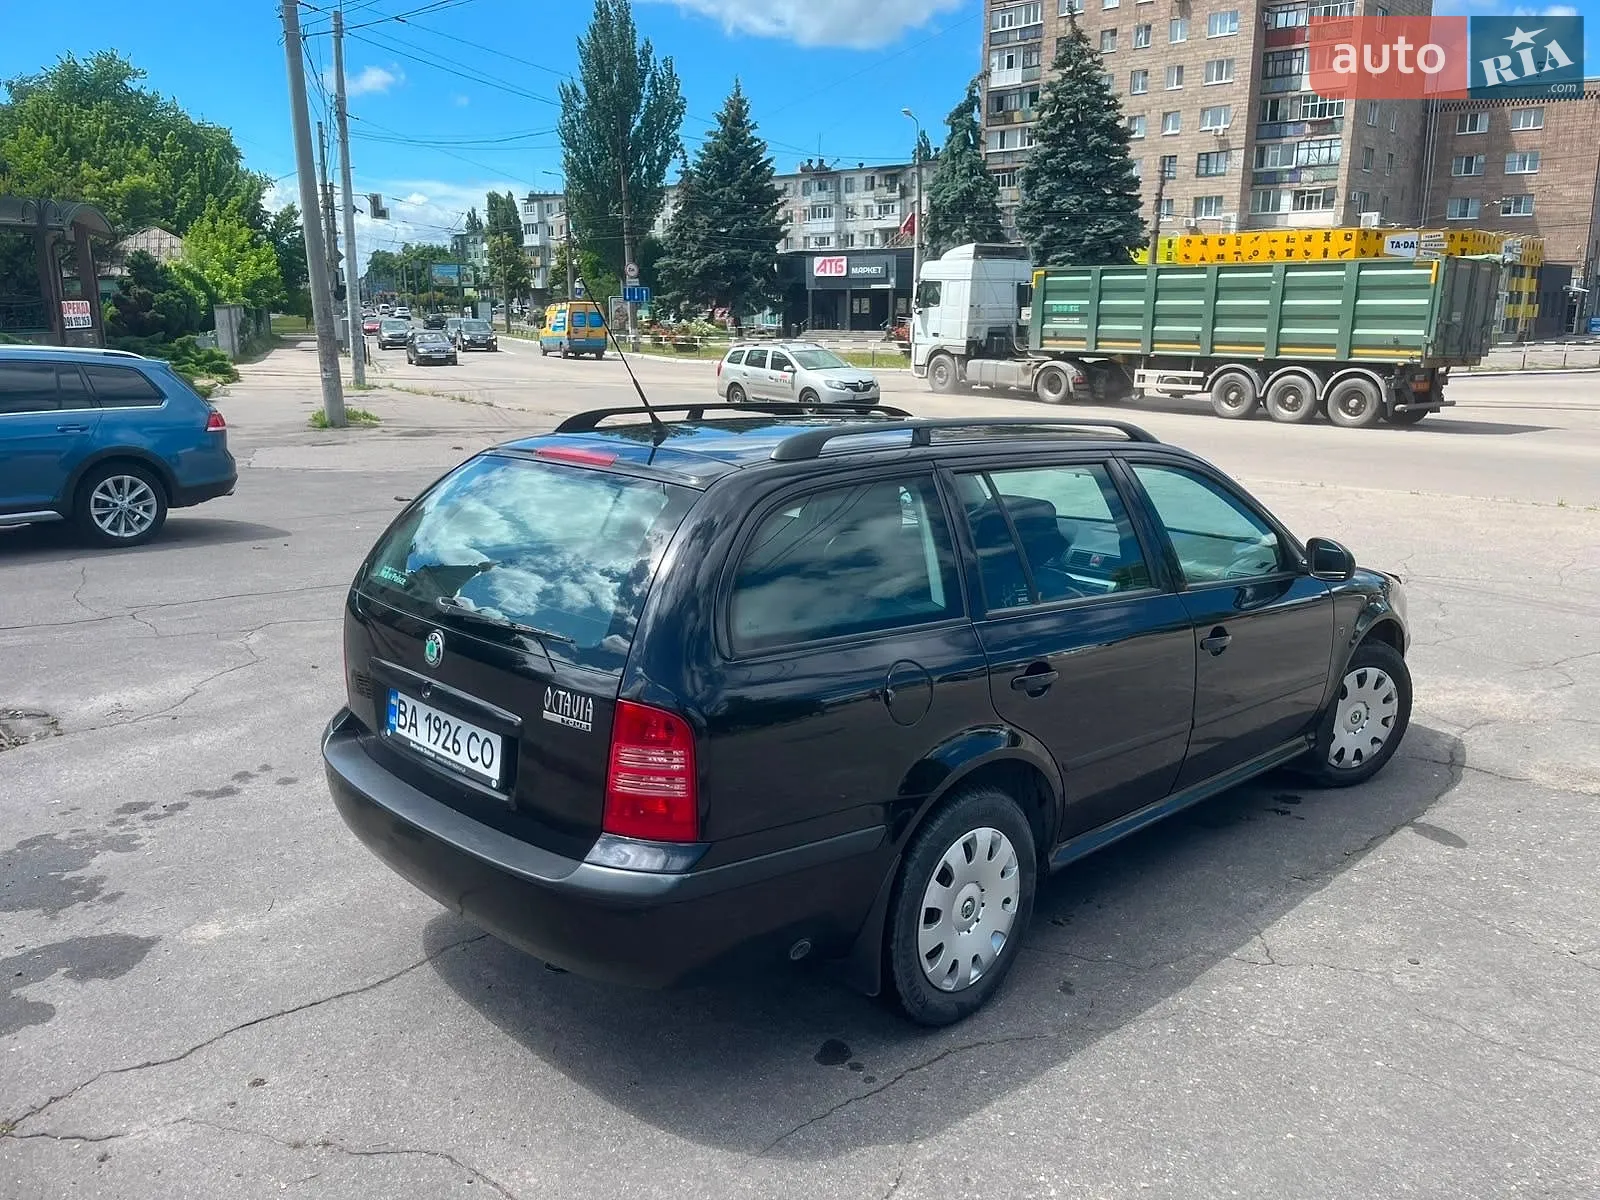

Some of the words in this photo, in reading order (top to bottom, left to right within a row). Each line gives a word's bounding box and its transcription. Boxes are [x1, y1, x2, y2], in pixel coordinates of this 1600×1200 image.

[815, 258, 845, 275] АТБ
[851, 266, 883, 274] МАРКЕТ
[543, 686, 594, 723] OCTAVIA
[397, 698, 419, 738] BA
[424, 712, 461, 756] 1926
[467, 731, 494, 769] CO
[562, 718, 588, 730] TOUR
